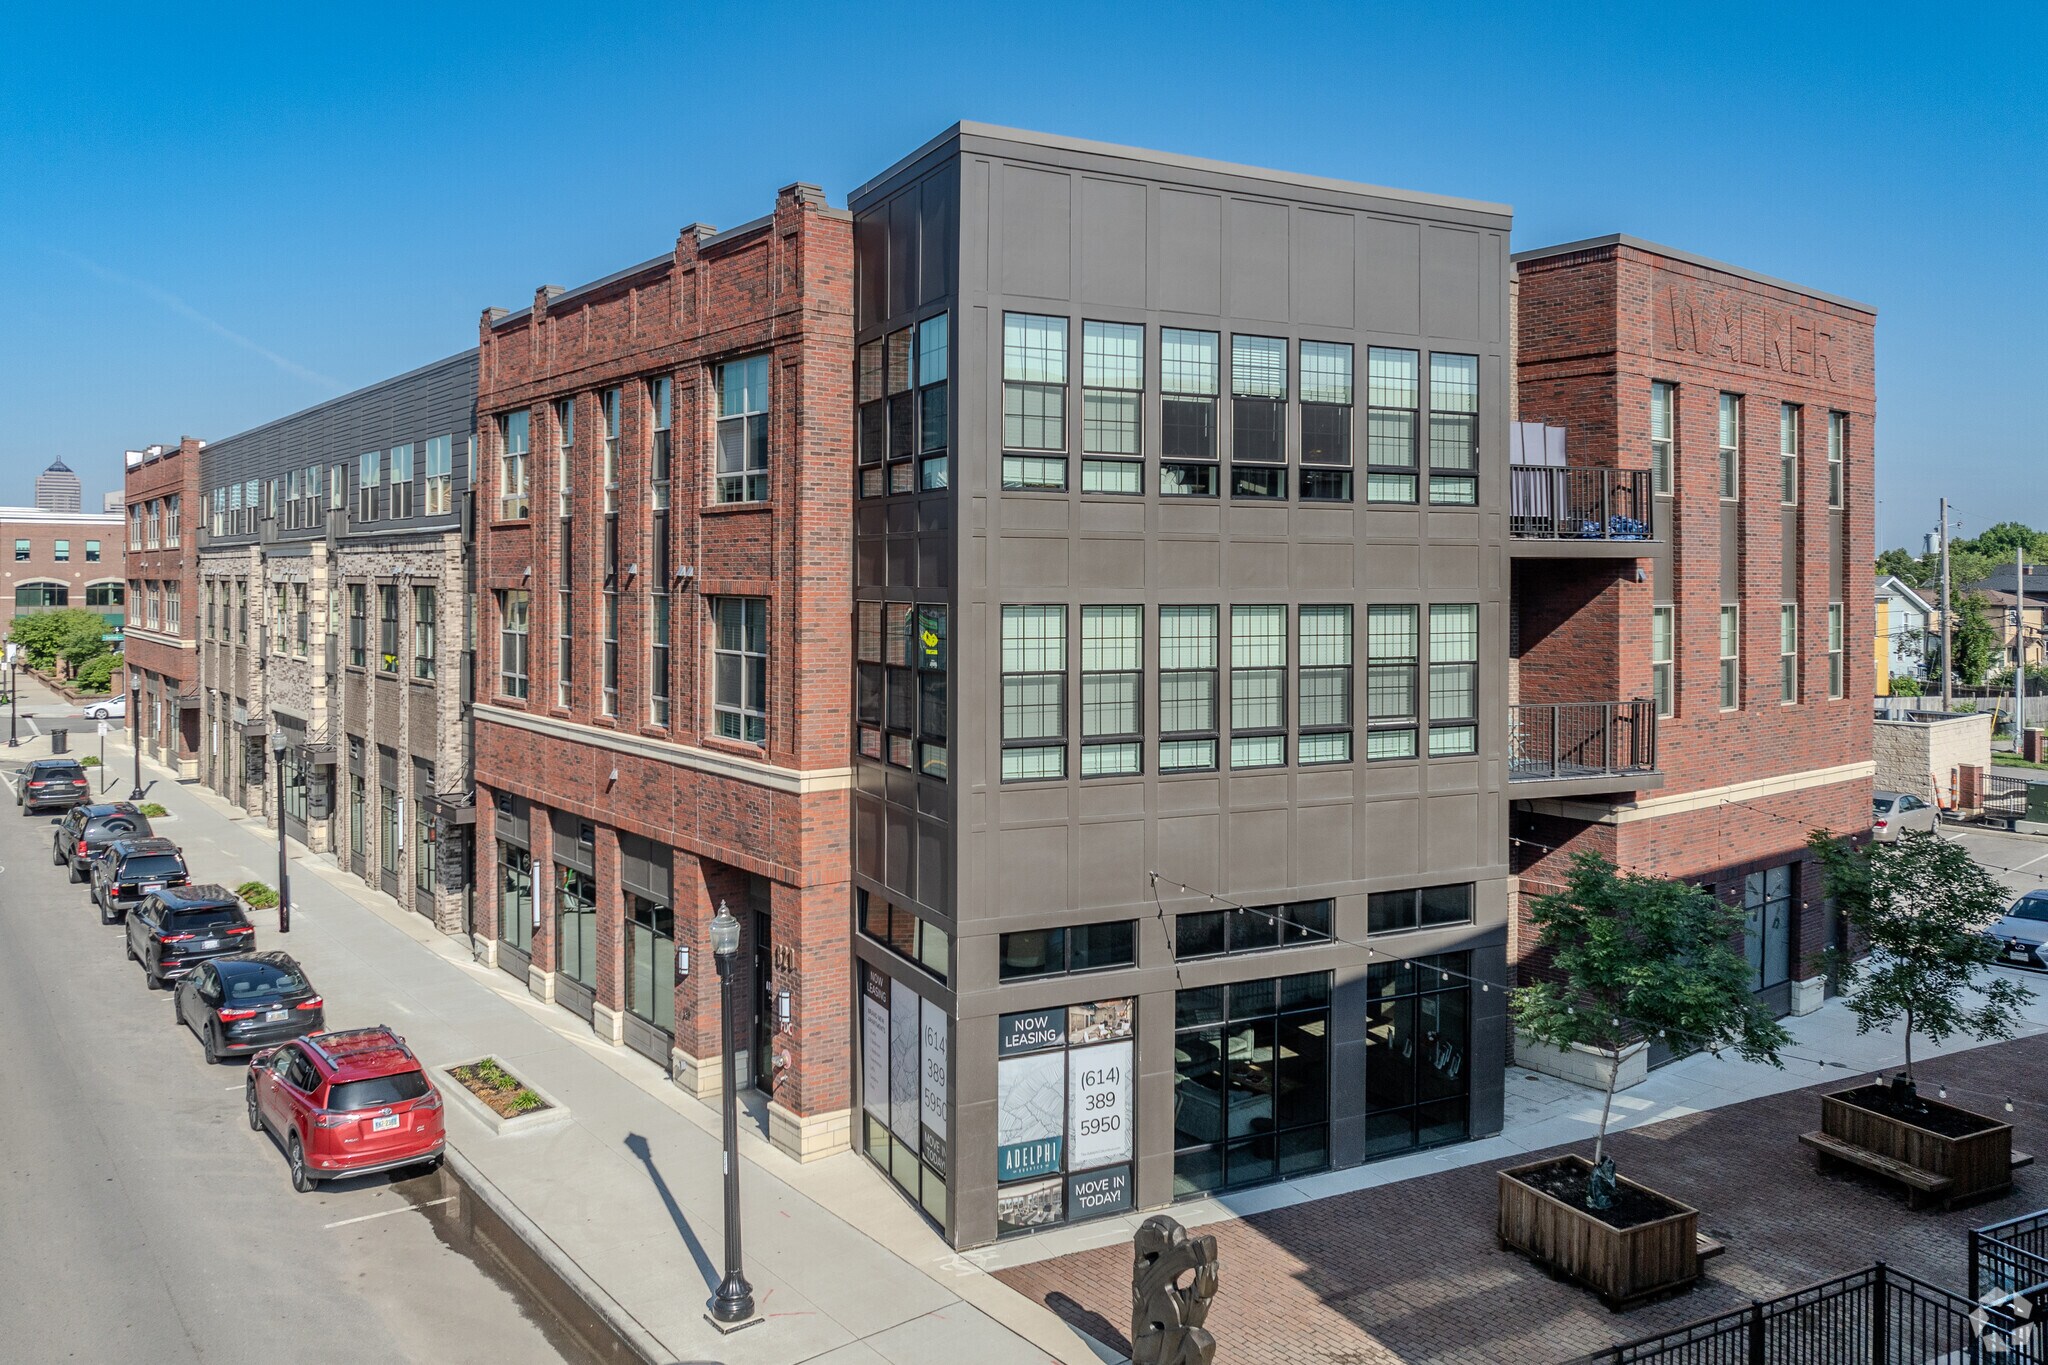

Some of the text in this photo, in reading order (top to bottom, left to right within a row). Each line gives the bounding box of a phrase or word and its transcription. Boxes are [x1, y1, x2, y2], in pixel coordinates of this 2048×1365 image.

[1670, 285, 1837, 383] WALKER
[870, 971, 884, 987] NOW
[866, 981, 887, 1003] LEASING
[1015, 1015, 1049, 1032] NOW
[1005, 1029, 1056, 1048] LEASING
[927, 1058, 945, 1087] 389
[1081, 1066, 1120, 1091] (614)
[924, 1087, 947, 1122] 5950
[1085, 1091, 1116, 1111] 389
[1080, 1114, 1121, 1137] 5950
[924, 1131, 941, 1153] MOVE
[1006, 1142, 1056, 1170] ADELPHI
[1075, 1175, 1125, 1196] MOVE IN
[1079, 1189, 1121, 1209] TODAY!
